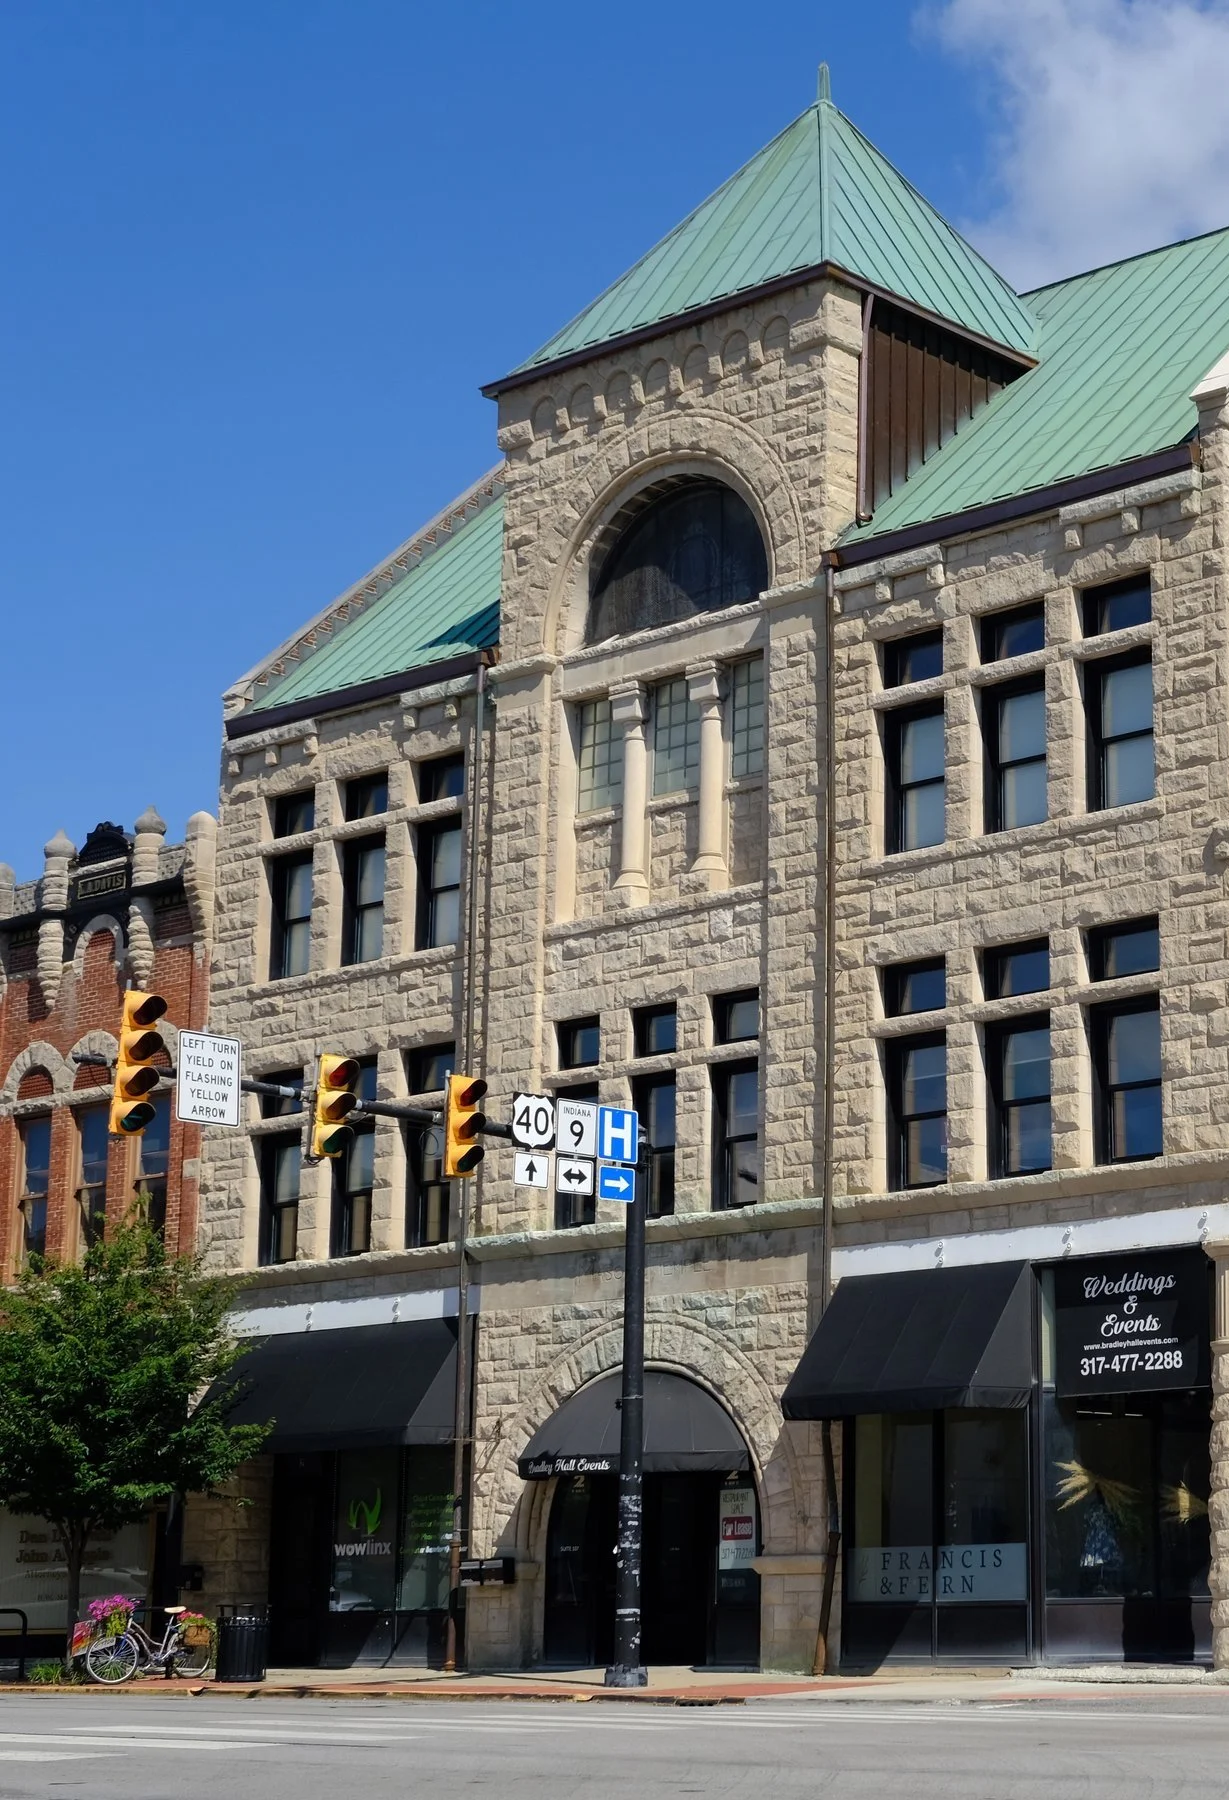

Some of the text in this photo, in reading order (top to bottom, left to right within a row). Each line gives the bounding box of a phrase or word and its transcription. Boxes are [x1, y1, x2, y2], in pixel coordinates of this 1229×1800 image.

[182, 1037, 237, 1055] LEFT TURN
[186, 1054, 233, 1071] YIELD ON
[185, 1070, 233, 1087] FLASHING
[190, 1087, 229, 1102] YELLOW
[191, 1105, 226, 1118] ARROW
[516, 1105, 549, 1136] 40
[563, 1106, 592, 1118] INDIANA
[569, 1119, 584, 1148] 9
[603, 1110, 632, 1160] H
[1083, 1271, 1177, 1299] Weddings
[1123, 1295, 1138, 1315] &
[1100, 1313, 1162, 1337] Events
[1083, 1336, 1179, 1351] www.bradleyhallevents.com
[1080, 1350, 1183, 1376] 317-477-2288
[528, 1457, 611, 1475] Bradley Hall Events
[573, 1475, 585, 1488] 2
[722, 1520, 752, 1536] For Lease
[334, 1538, 392, 1557] wowlinx
[881, 1548, 1003, 1571] FRANCIS
